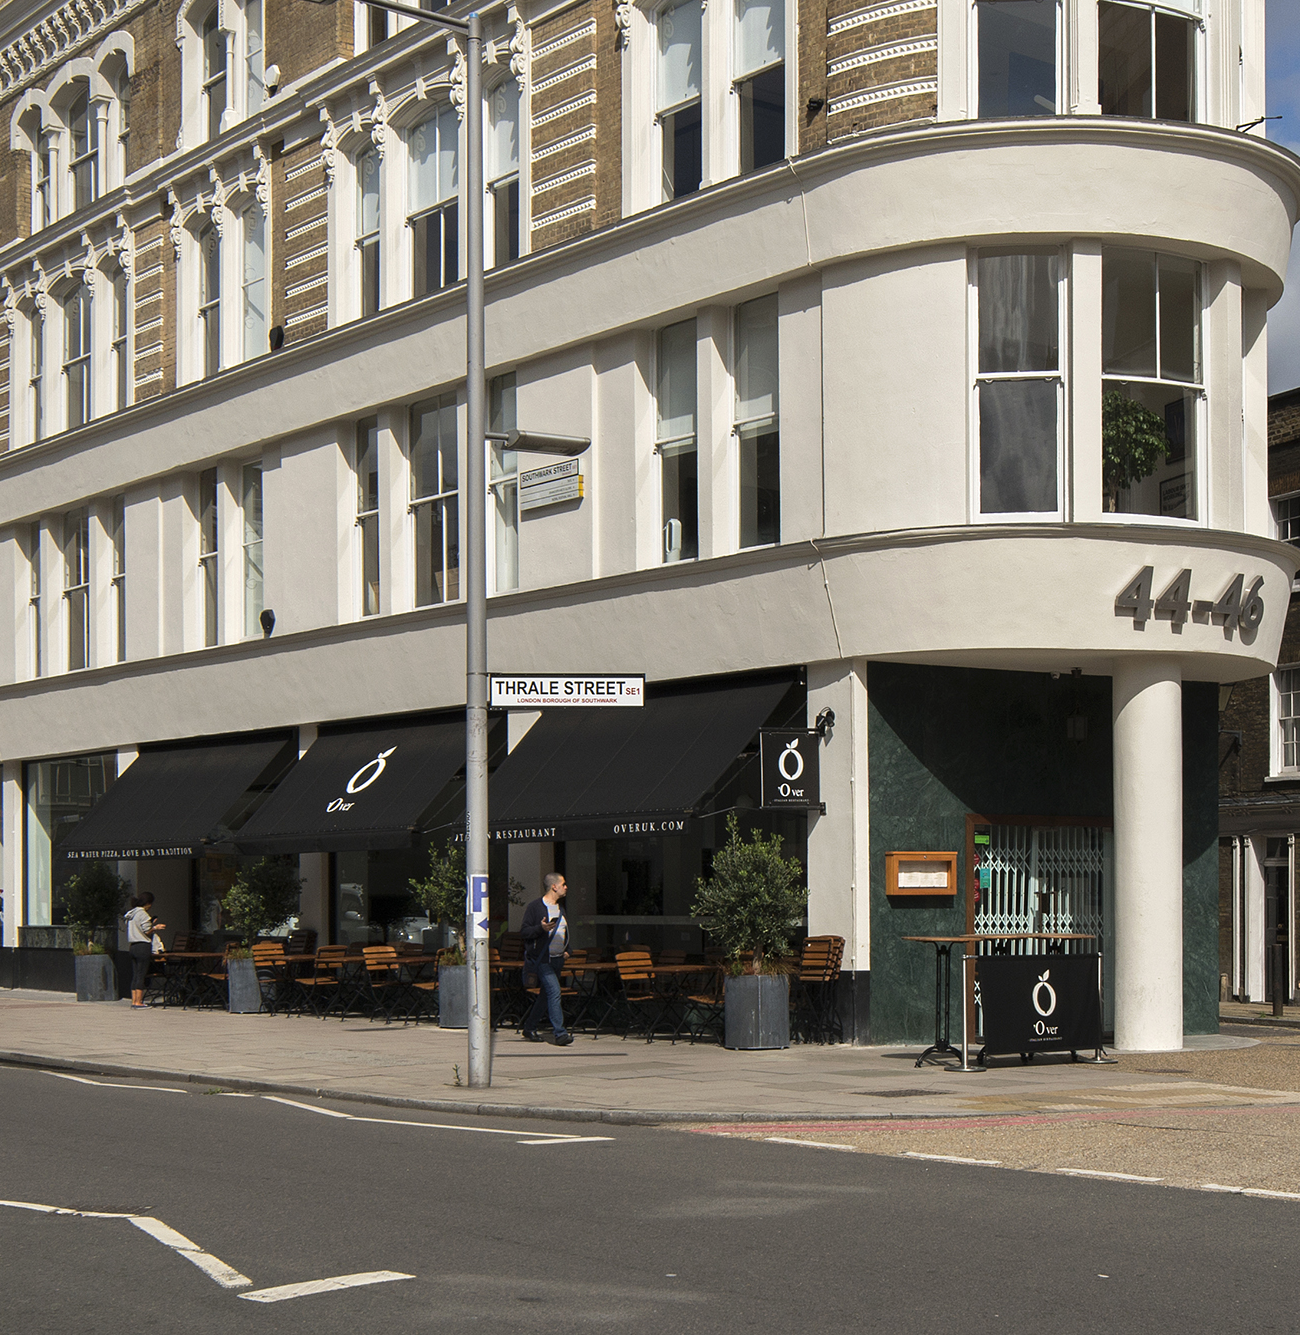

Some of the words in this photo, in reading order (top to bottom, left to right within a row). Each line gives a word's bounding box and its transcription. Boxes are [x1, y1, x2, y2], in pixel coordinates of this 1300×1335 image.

[522, 469, 552, 482] SOUTHWARK
[553, 463, 572, 474] STREET
[1115, 565, 1264, 632] 44-46
[495, 681, 559, 695] THRALE
[564, 681, 625, 695] STREET
[496, 828, 555, 839] RESTAURANT
[614, 821, 684, 834] OVERUK.COM
[101, 850, 120, 858] PIZZA,
[157, 848, 192, 856] TRADITION
